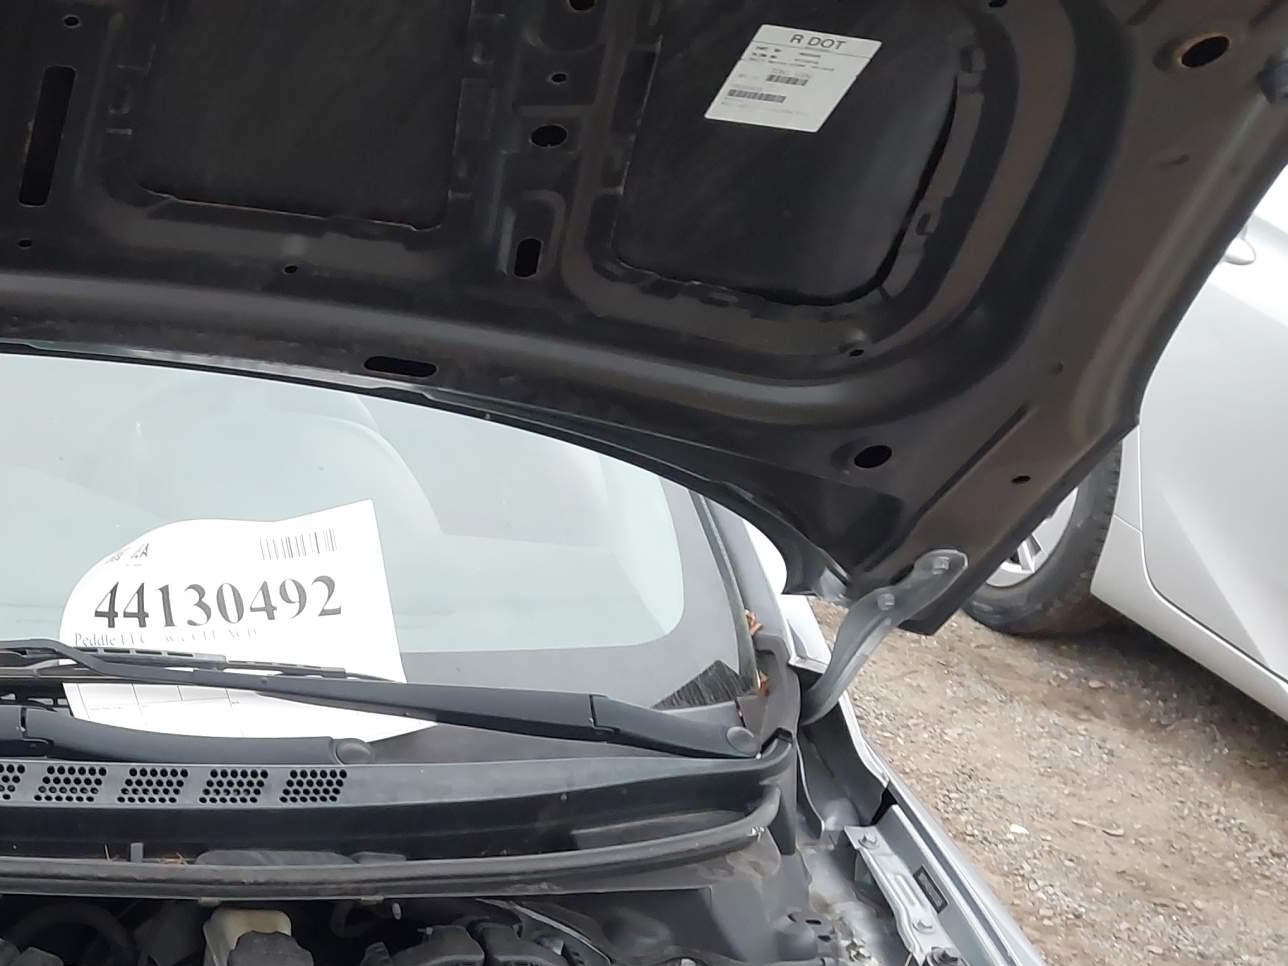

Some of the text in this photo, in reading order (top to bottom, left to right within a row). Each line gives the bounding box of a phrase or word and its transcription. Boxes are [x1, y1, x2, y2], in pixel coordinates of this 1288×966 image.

[789, 33, 847, 51] R DOT
[94, 574, 342, 628] 44130492
